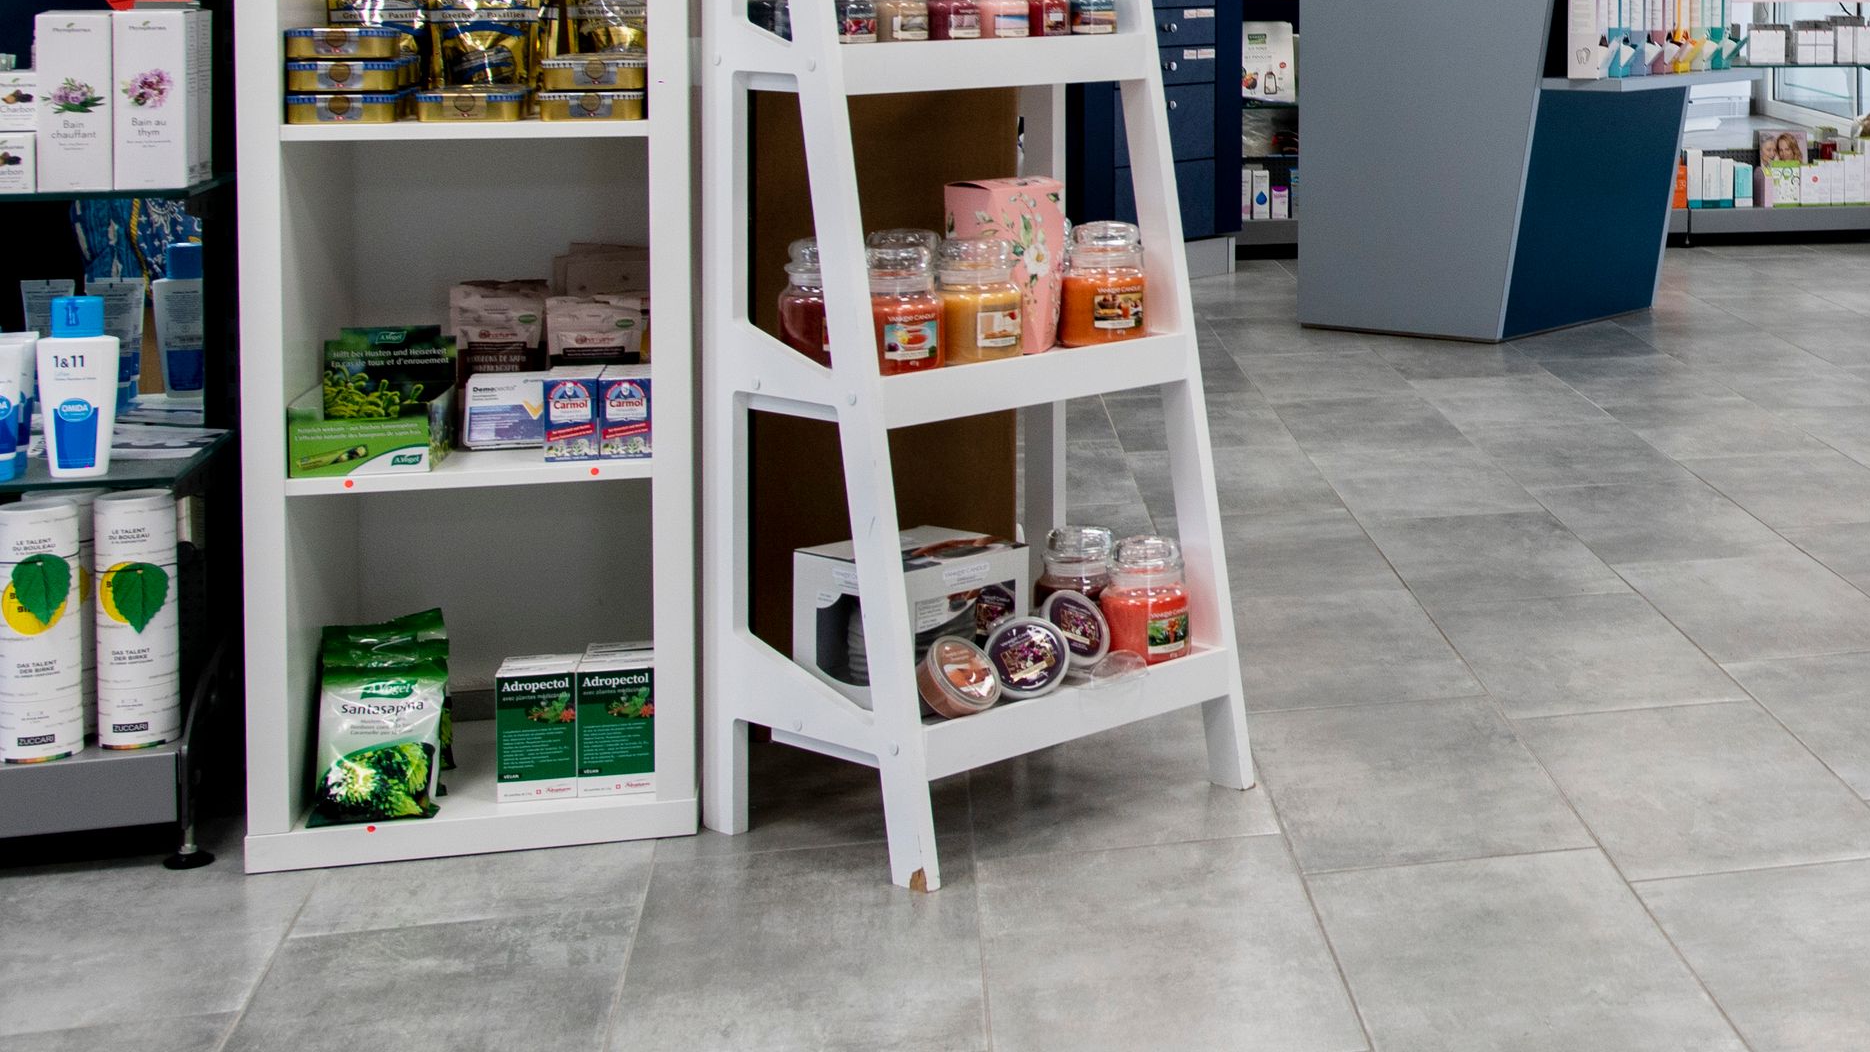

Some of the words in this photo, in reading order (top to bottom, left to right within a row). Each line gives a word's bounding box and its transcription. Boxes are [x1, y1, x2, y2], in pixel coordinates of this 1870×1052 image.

[63, 119, 84, 129] Bain
[131, 117, 152, 127] Bain
[155, 119, 167, 127] au
[51, 130, 96, 140] chauffant
[138, 128, 160, 138] thym
[351, 350, 363, 358] bei
[410, 348, 447, 356] Heiserkeit
[53, 355, 84, 368] 1&11
[396, 356, 449, 366] d'enrouement
[61, 403, 90, 413] OMIDA
[554, 400, 588, 409] Carmol
[610, 399, 644, 408] Carmol
[395, 455, 420, 464] A.Vogel
[501, 677, 570, 693] Adropectol
[582, 673, 649, 687] Adropectol
[113, 723, 148, 733] ZUCCARI
[18, 735, 54, 745] ZUCCARI
